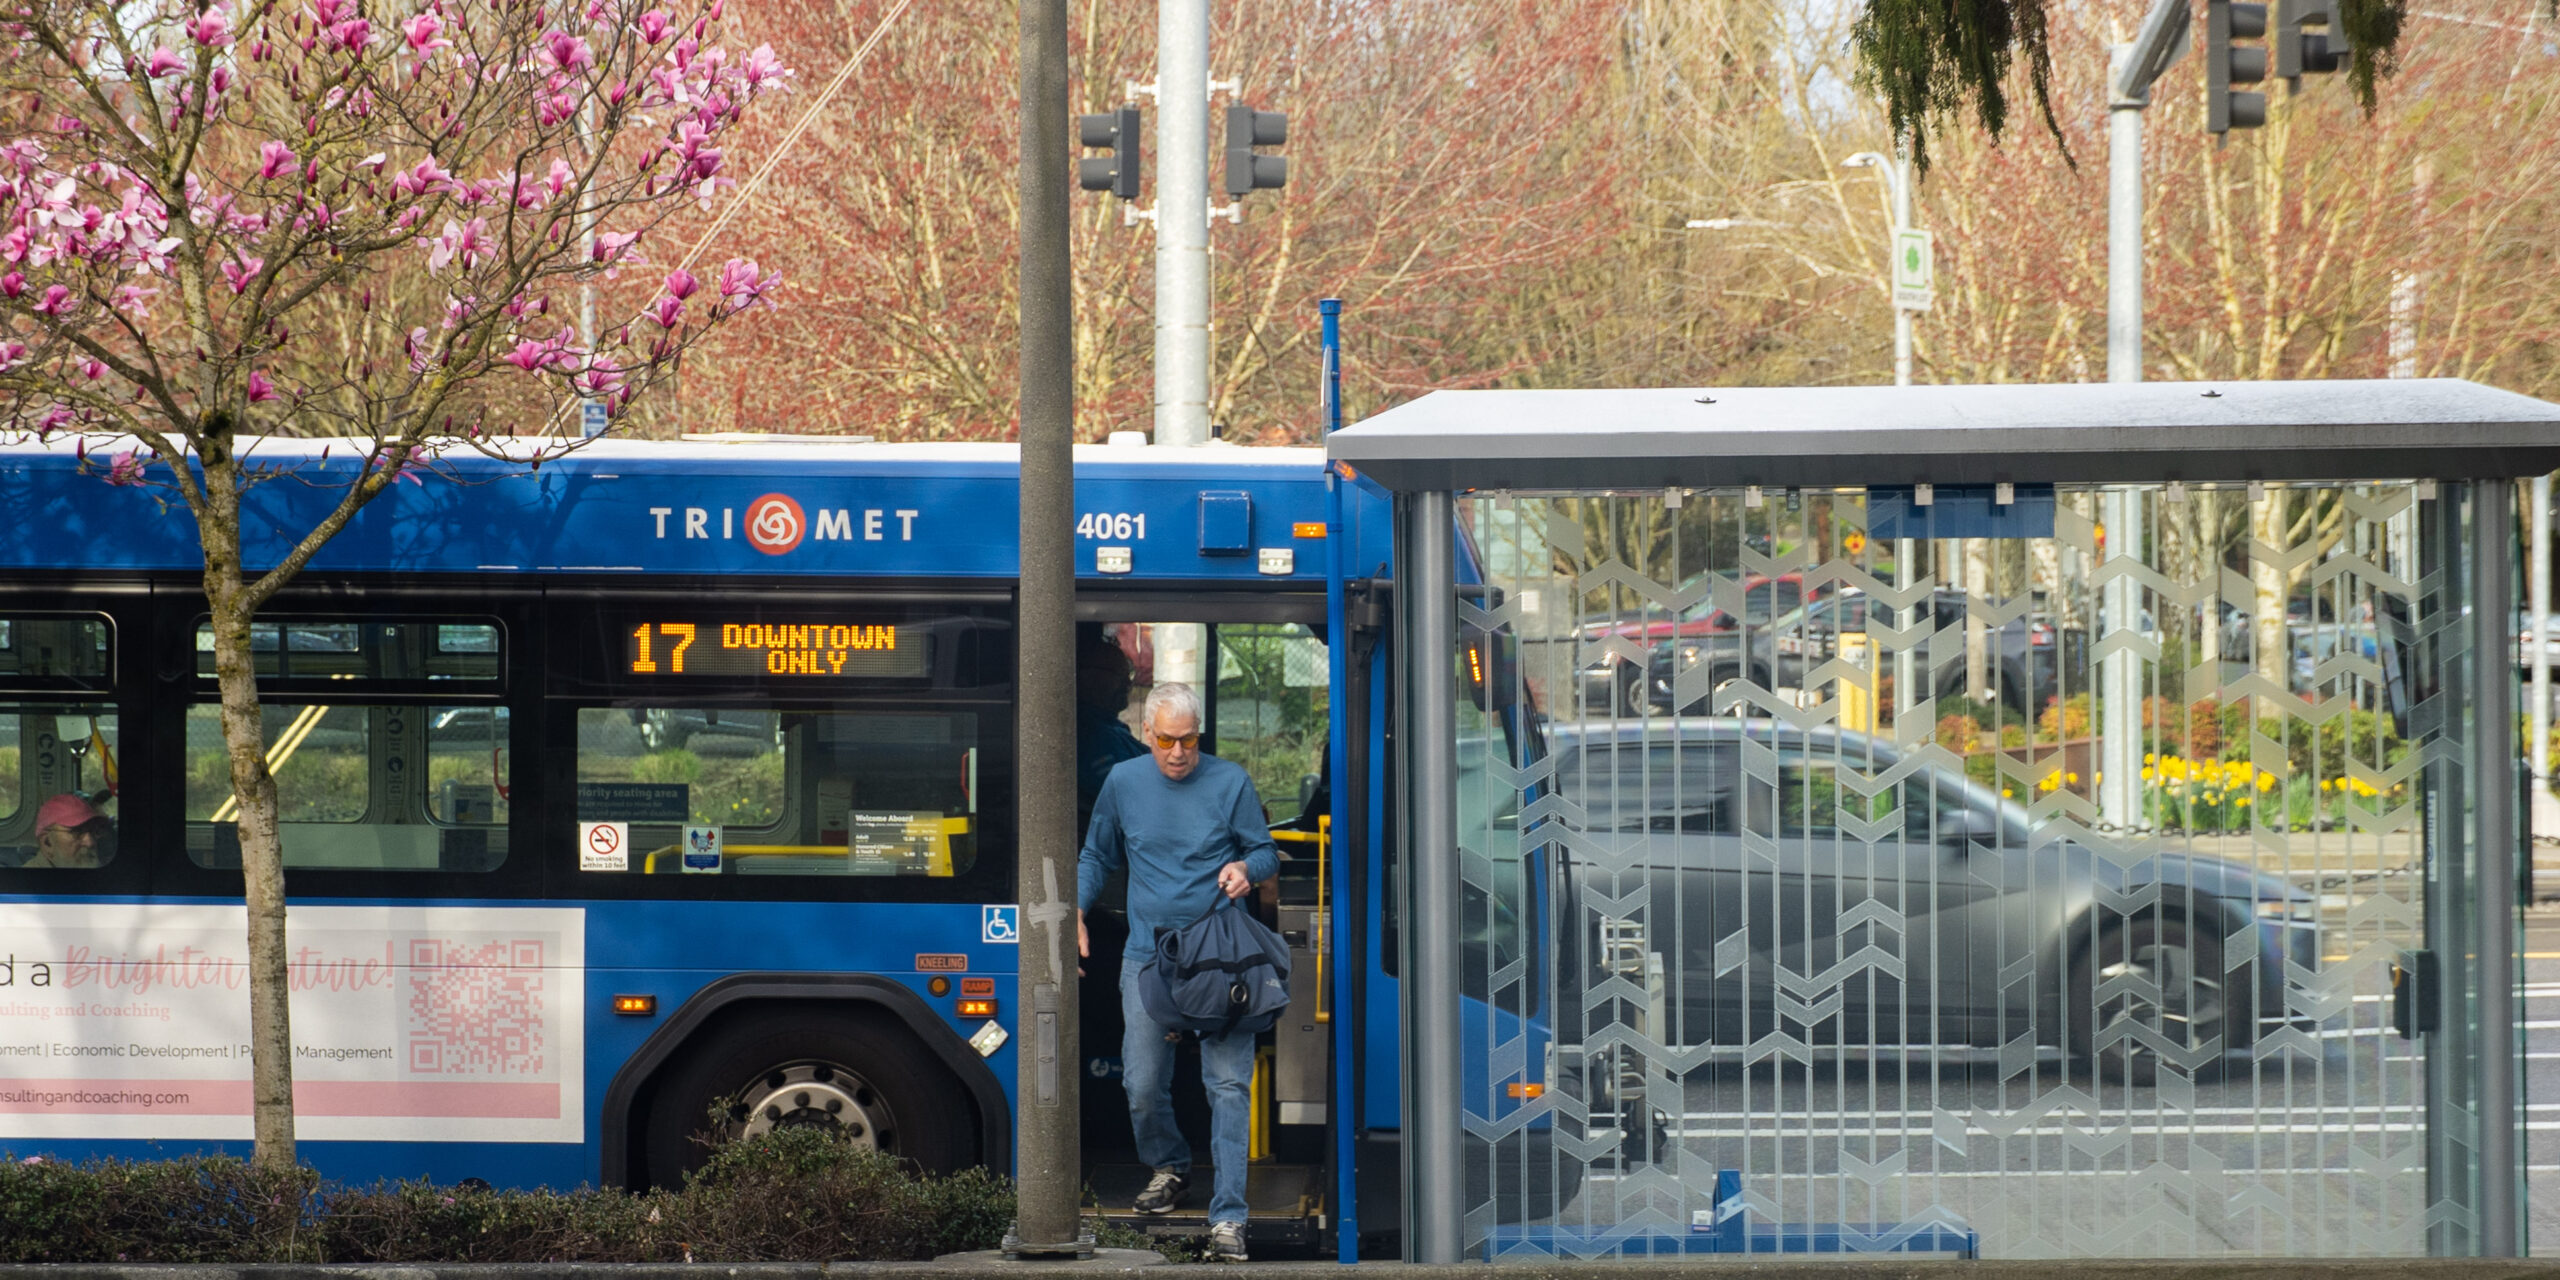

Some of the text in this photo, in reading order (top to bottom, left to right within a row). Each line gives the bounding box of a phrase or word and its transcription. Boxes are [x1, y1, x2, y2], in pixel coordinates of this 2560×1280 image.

[649, 507, 918, 541] TRI MET
[1076, 512, 1145, 539] 4061
[632, 623, 895, 672] 17 DOWNTOWN
[767, 650, 848, 674] ONLY
[577, 787, 678, 800] riority seating area
[855, 814, 913, 822] Welcome Aboard
[595, 855, 623, 863] smoking
[31, 963, 50, 986] a
[62, 944, 246, 995] Brighter
[919, 957, 964, 969] KNEELING
[963, 981, 992, 991] RAMP
[55, 1002, 86, 1017] and
[91, 1002, 170, 1021] Coaching
[53, 1043, 125, 1057] Economic
[129, 1044, 228, 1060] Development
[296, 1045, 393, 1061] Management
